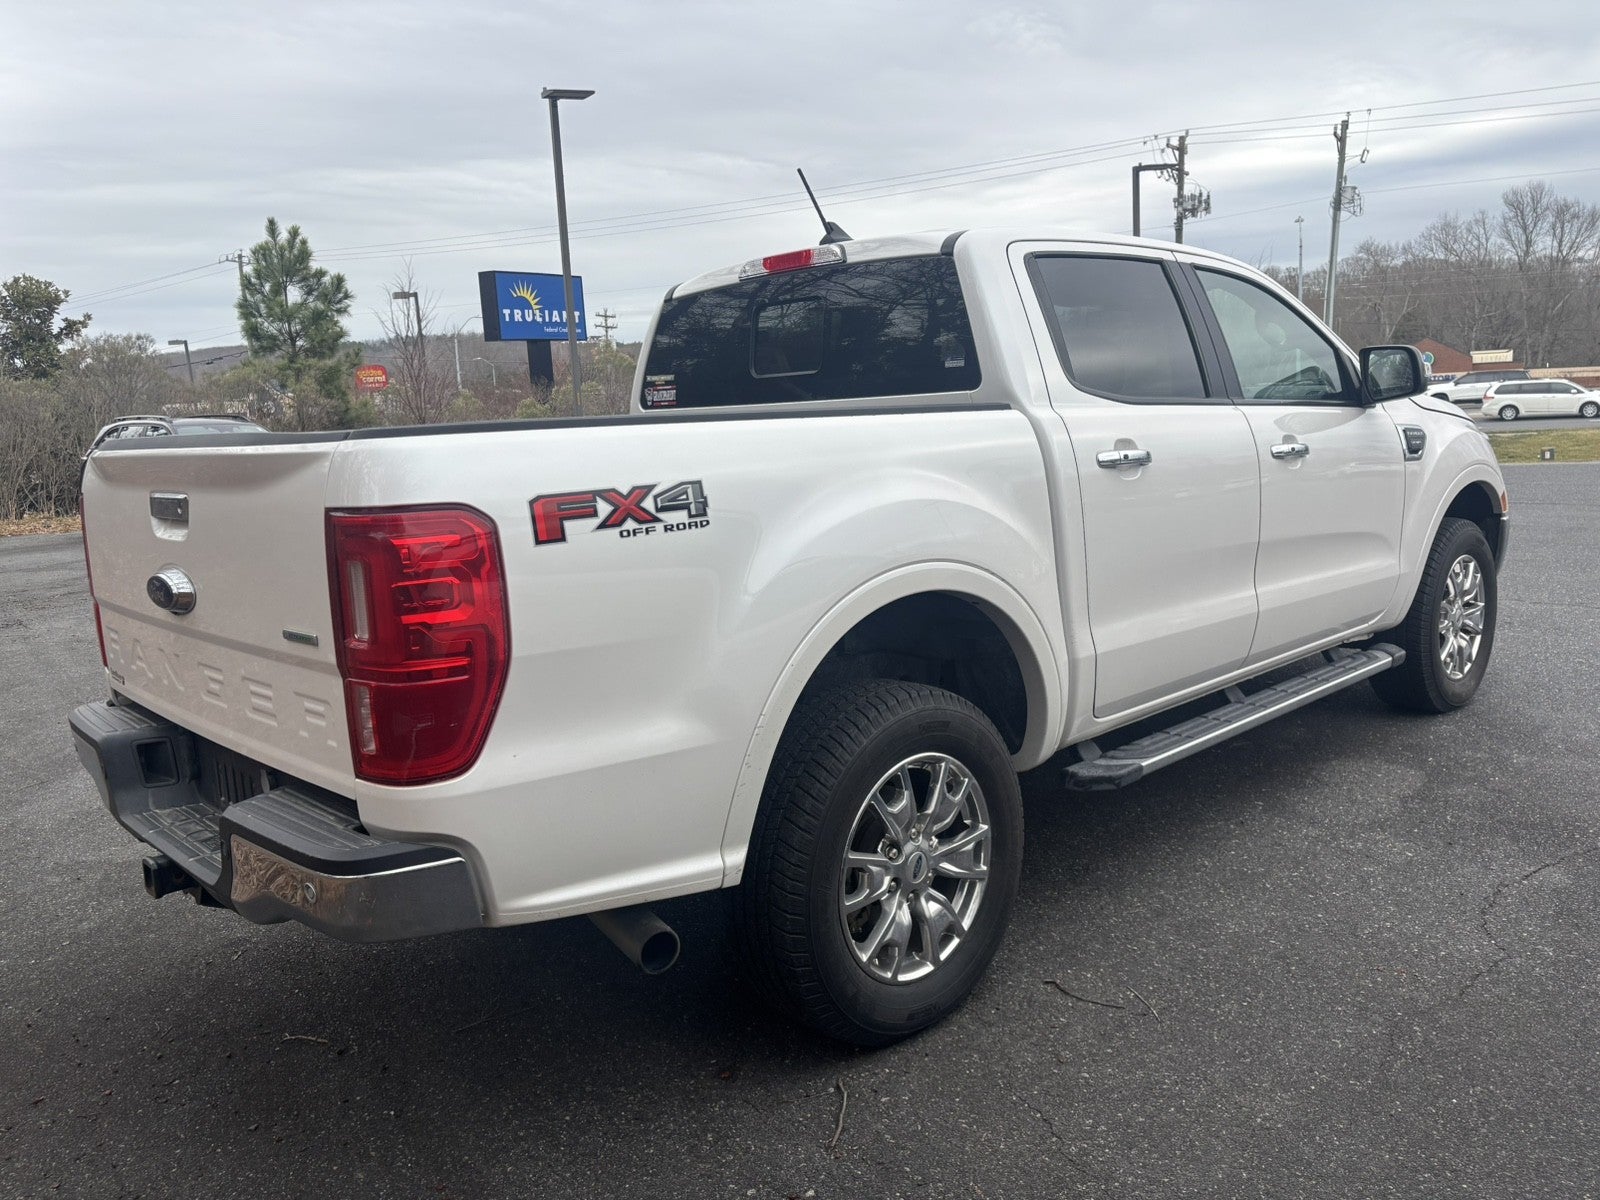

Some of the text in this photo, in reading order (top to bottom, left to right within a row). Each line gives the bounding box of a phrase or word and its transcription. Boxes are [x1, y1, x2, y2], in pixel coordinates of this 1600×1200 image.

[529, 479, 708, 545] FX4
[619, 519, 710, 538] OFF ROAD
